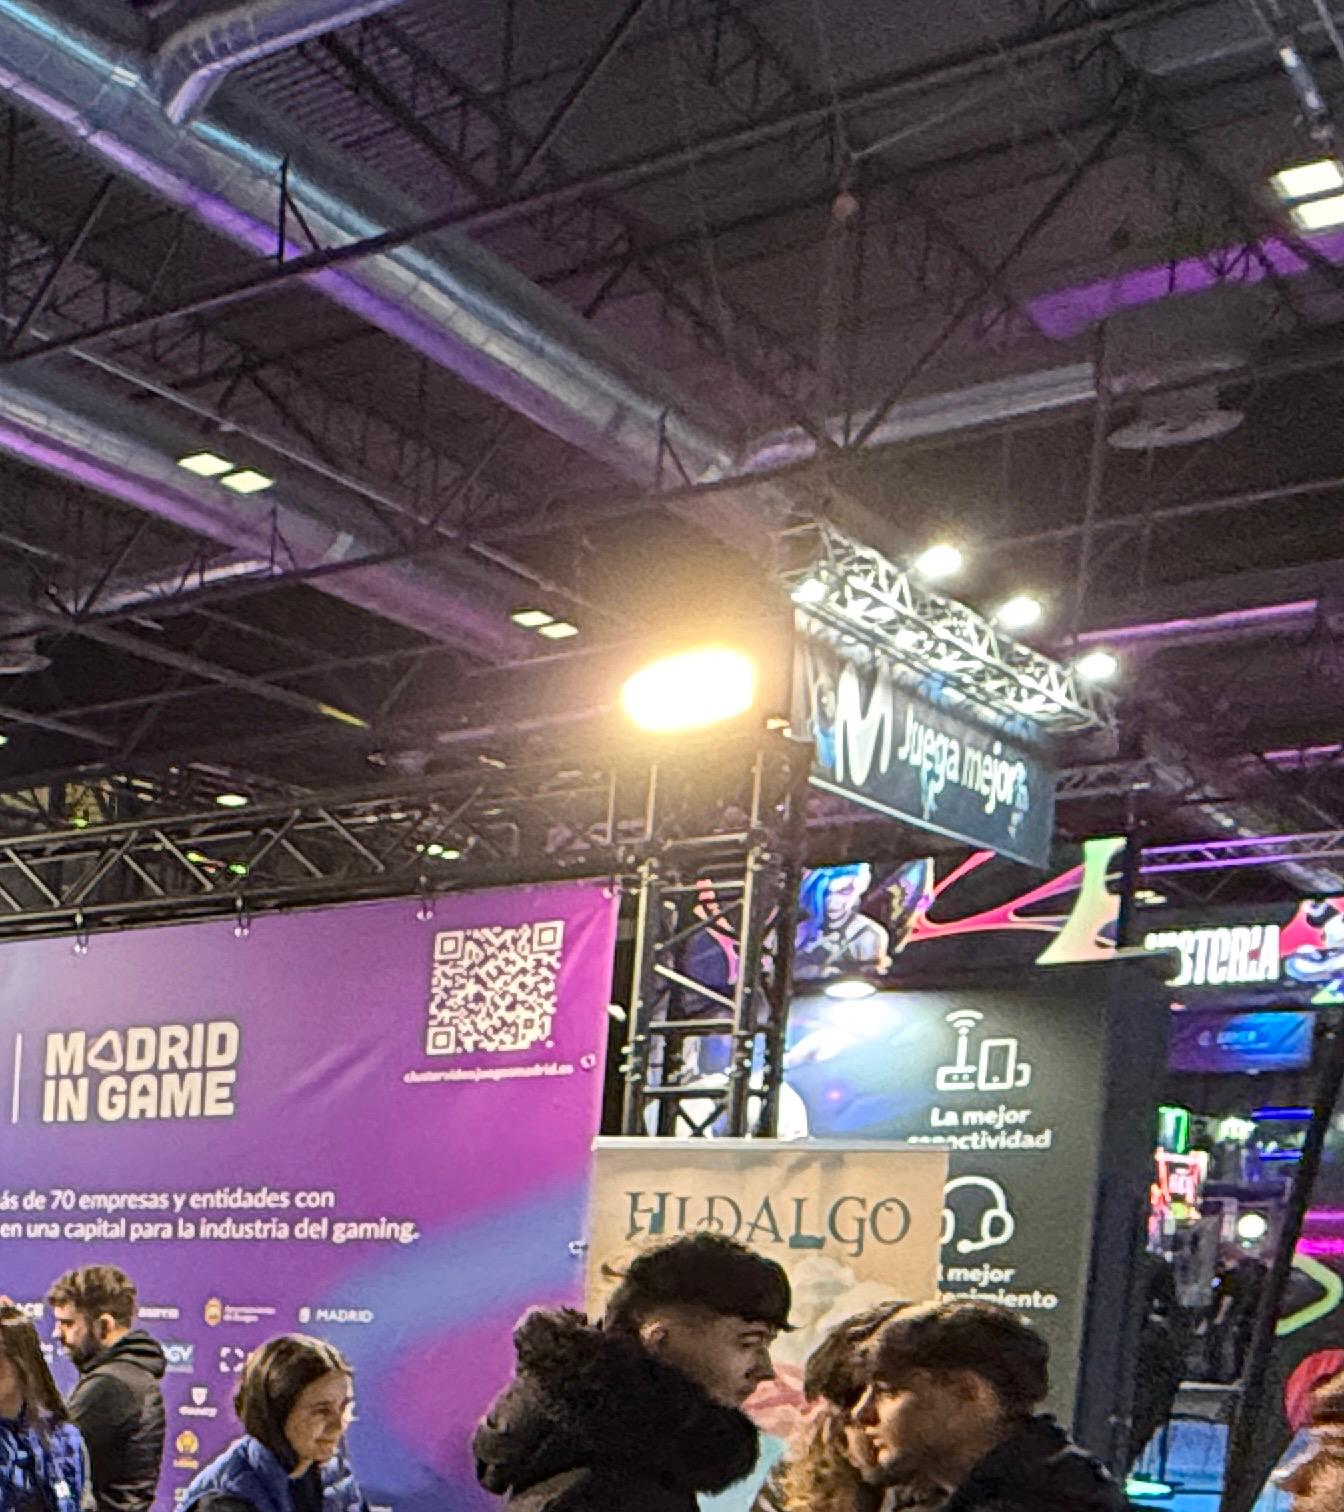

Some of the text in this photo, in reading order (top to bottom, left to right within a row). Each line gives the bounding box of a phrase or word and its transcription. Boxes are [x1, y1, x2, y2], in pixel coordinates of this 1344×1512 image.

[898, 702, 1026, 815] Juega mejor
[1145, 924, 1280, 985] STORIA
[44, 1020, 240, 1077] MADRID
[42, 1069, 237, 1124] IN GAME
[930, 1104, 1032, 1130] La mejor
[22, 1189, 46, 1210] de
[50, 1189, 75, 1210] 70
[78, 1192, 170, 1214] empresas
[173, 1193, 185, 1213] y
[189, 1187, 291, 1209] entidades
[294, 1191, 335, 1208] con
[625, 1190, 912, 1257] HIDALGO
[0, 1223, 20, 1238] en
[26, 1221, 60, 1238] una
[63, 1217, 126, 1241] capital
[130, 1221, 173, 1242] para
[177, 1217, 196, 1238] la
[200, 1216, 289, 1239] industria
[294, 1216, 328, 1239] del
[332, 1217, 421, 1244] gaming.
[947, 1262, 1016, 1287] mejor
